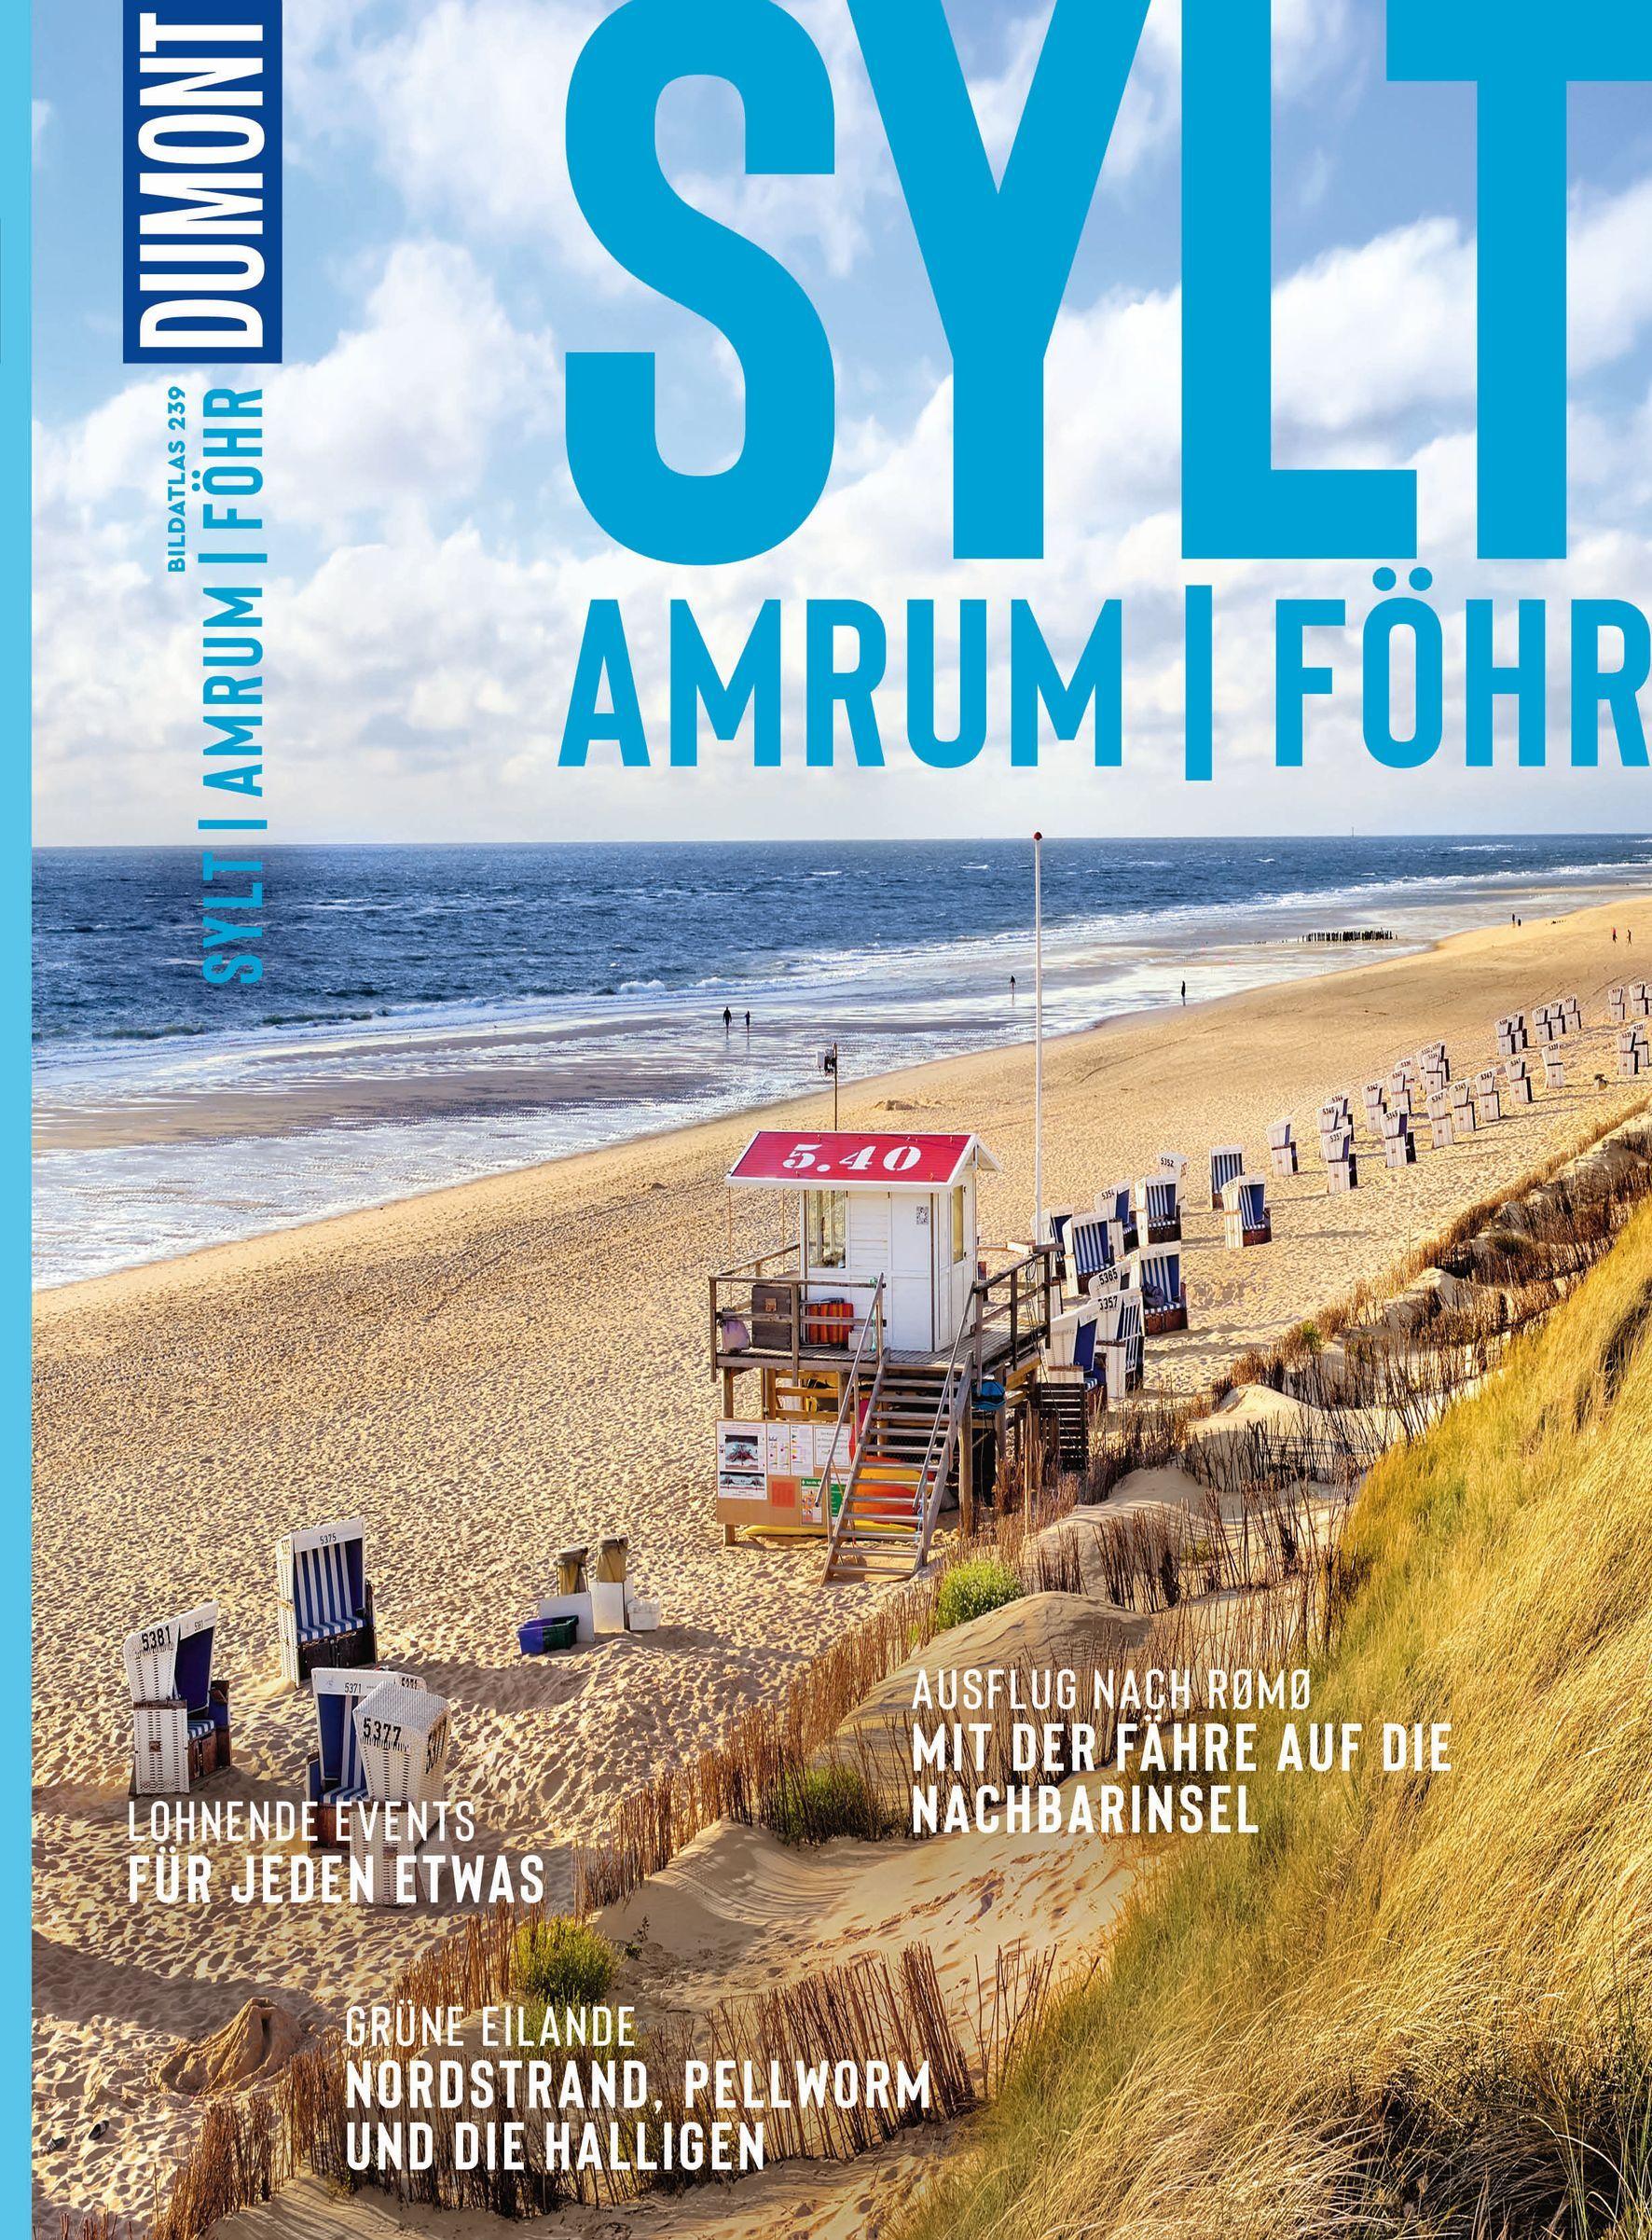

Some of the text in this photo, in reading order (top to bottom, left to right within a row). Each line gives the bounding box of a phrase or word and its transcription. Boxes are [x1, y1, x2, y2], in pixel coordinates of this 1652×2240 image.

[782, 1143, 922, 1172] 5.40
[1098, 1267, 1118, 1286] 5365
[319, 1532, 337, 1545] 5375
[141, 1625, 172, 1652] 5381
[344, 1681, 363, 1694] 5371
[363, 1716, 402, 1749] 5377
